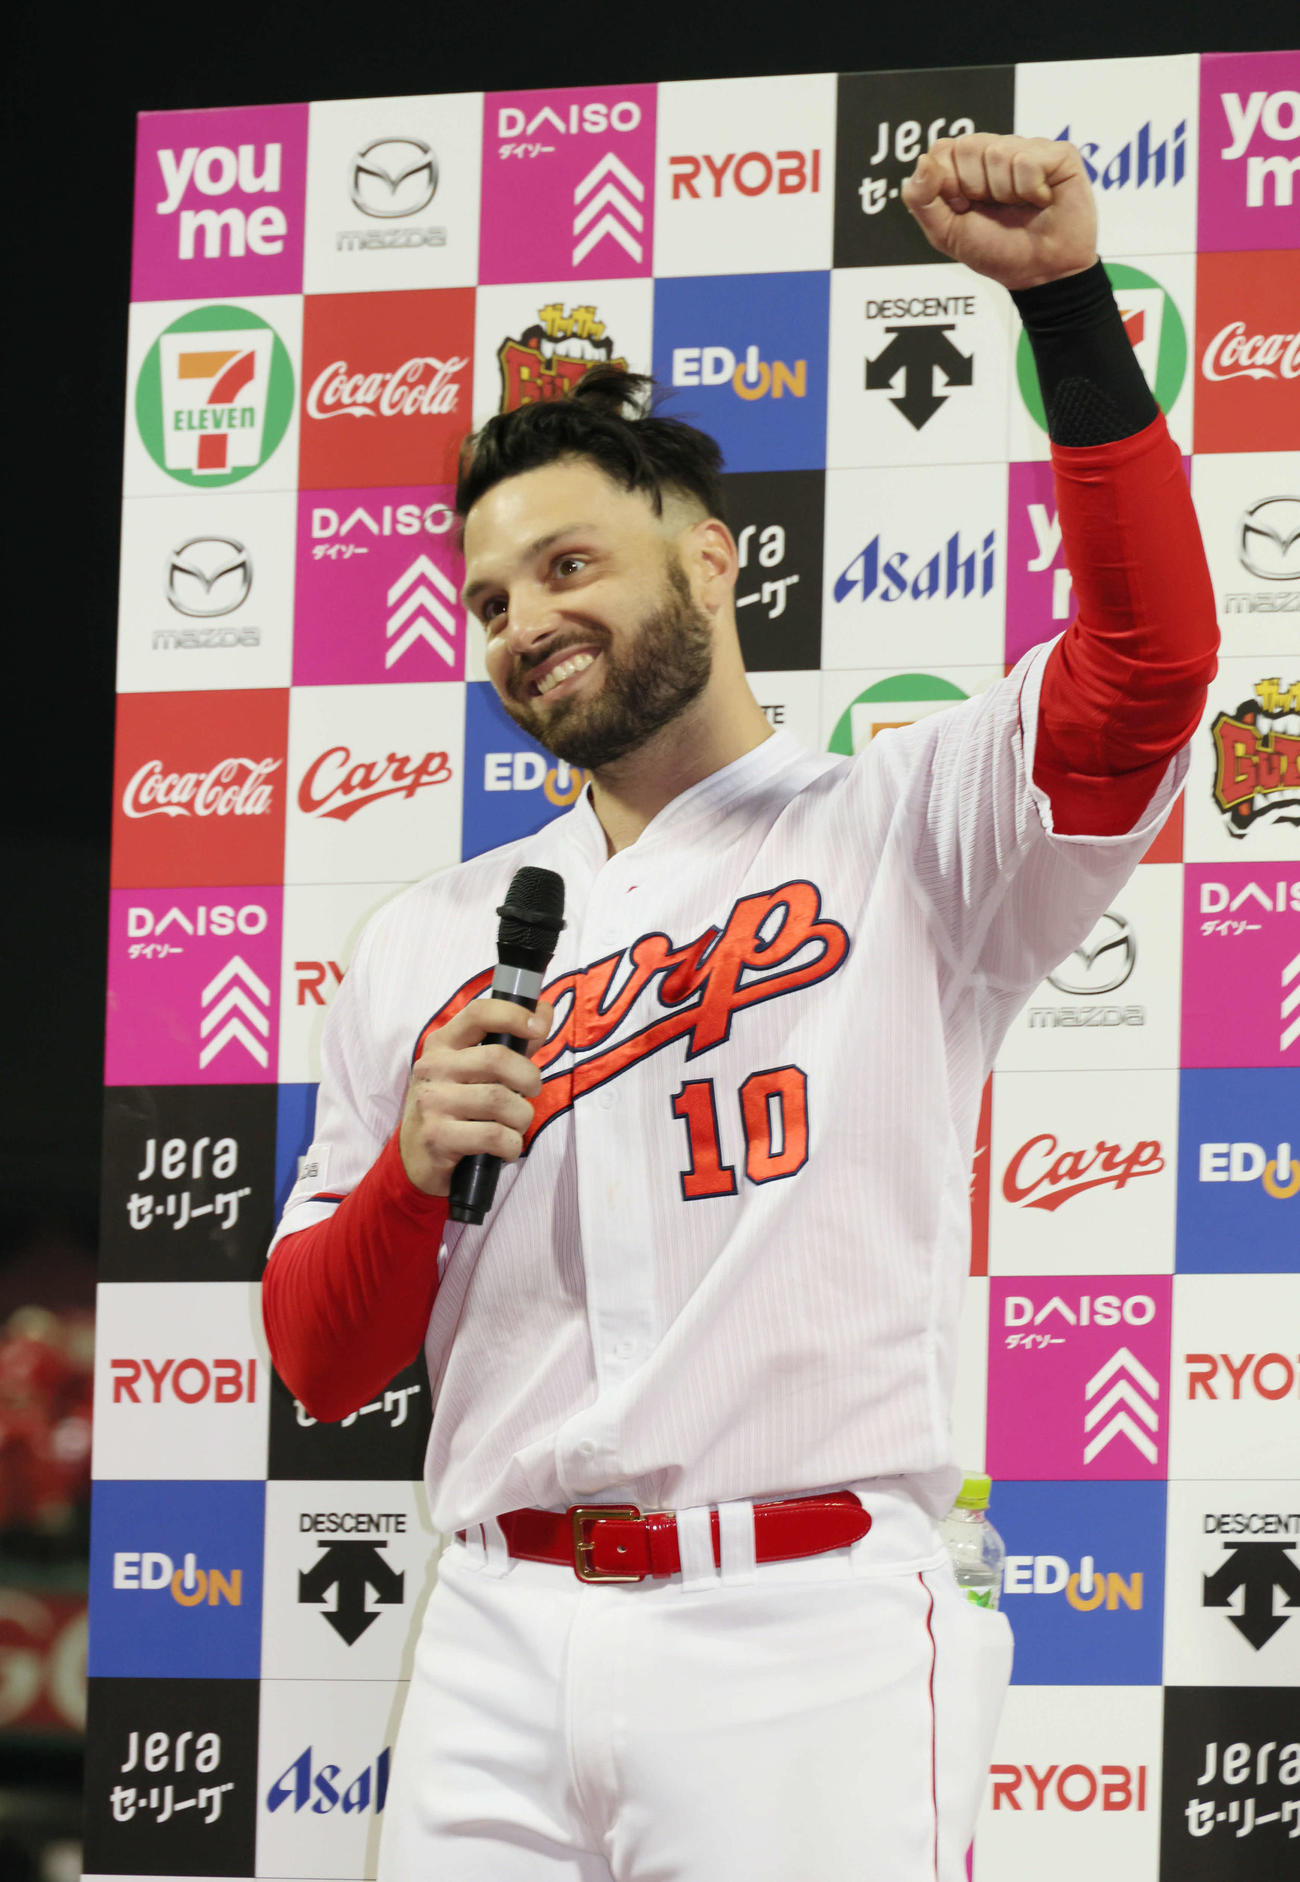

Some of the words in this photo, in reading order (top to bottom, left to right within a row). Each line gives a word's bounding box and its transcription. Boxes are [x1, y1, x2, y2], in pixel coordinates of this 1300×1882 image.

[499, 102, 641, 138] DAISO
[1220, 90, 1300, 160] yo
[499, 143, 555, 159] ダイソー
[669, 149, 820, 199] RYOBI
[1054, 119, 1186, 190] sahi
[157, 143, 282, 215] you
[1246, 156, 1300, 207] m
[178, 204, 287, 259] me
[337, 227, 446, 251] mazda
[866, 296, 974, 319] DESCENTE
[672, 346, 806, 400] EDION
[1202, 322, 1300, 381] Coca-
[307, 357, 467, 419] Coca-Cola
[312, 504, 454, 538] DAISO
[312, 544, 368, 560] ダイソー
[738, 525, 785, 568] ra
[833, 531, 994, 603] Asahi
[1225, 592, 1300, 614] maz
[152, 627, 260, 650] mazda
[123, 758, 283, 818] Coca-Cola
[298, 746, 452, 821] Carp
[484, 752, 592, 806] EDIO
[1200, 882, 1300, 913] DAI
[128, 905, 267, 937] DAISO
[1201, 920, 1261, 936] ダイソー
[128, 944, 182, 958] ダイソー
[1027, 1005, 1146, 1028] mazda
[671, 1064, 809, 1201] 10
[1002, 1134, 1164, 1212] Carp
[1199, 1143, 1300, 1199] EDIO
[127, 1188, 250, 1229] セ・リーグ
[1005, 1295, 1155, 1326] DAISO
[1005, 1334, 1065, 1349] ダイソー
[111, 1358, 256, 1404] RYOBI
[1186, 1353, 1300, 1400] RYO
[300, 1513, 406, 1533] DESCENTE
[1205, 1514, 1300, 1534] DESCENT
[114, 1553, 241, 1606] EDION
[1003, 1555, 1143, 1611] EDION
[110, 1783, 234, 1823] セ・リーグ
[990, 1764, 1146, 1811] RYOBI
